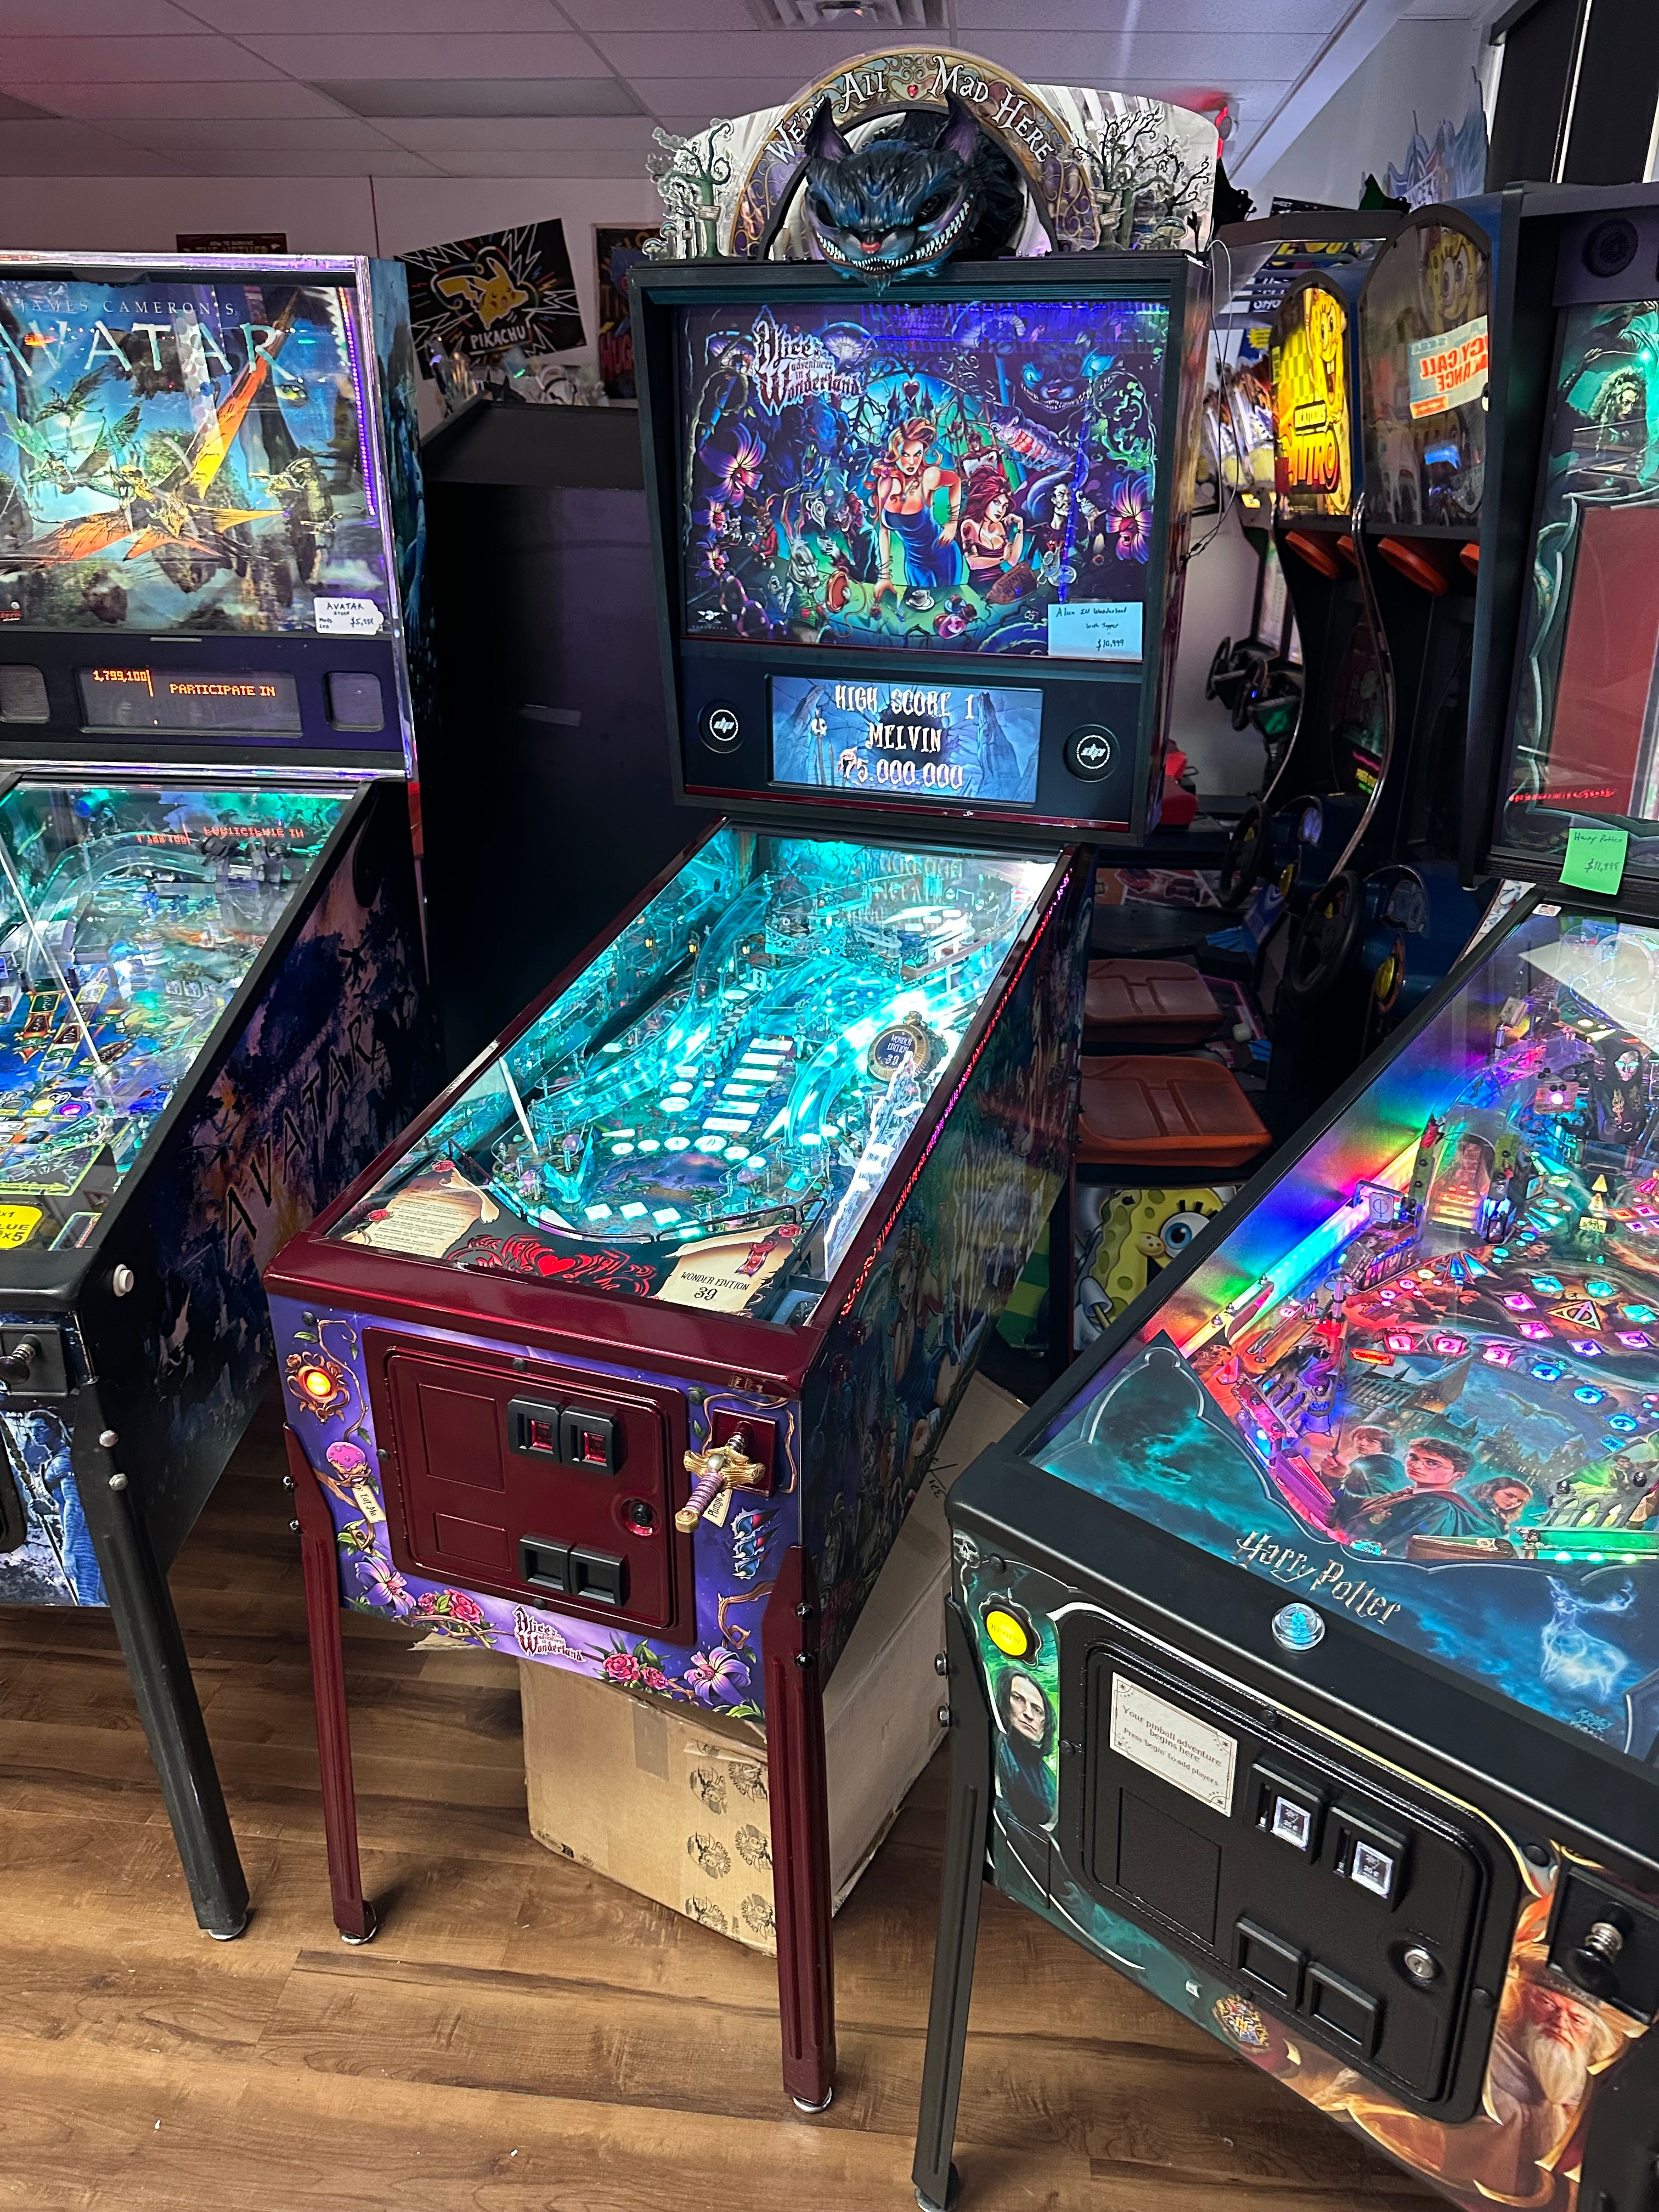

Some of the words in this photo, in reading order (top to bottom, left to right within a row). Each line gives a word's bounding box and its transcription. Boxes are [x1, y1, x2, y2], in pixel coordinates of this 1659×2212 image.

[21, 300, 88, 313] JAMES
[470, 327, 527, 349] PIKACHU
[326, 602, 365, 611] AVATAR
[93, 670, 148, 682] 1,799,100
[169, 683, 256, 696] PARTICIPATE
[259, 686, 276, 697] IN
[834, 685, 878, 713] HIGH
[890, 688, 952, 718] SCORE
[964, 693, 975, 720] 1
[865, 722, 943, 753] MELVIN
[680, 1272, 715, 1286] WONDER
[715, 1278, 751, 1291] EDITION
[693, 1286, 718, 1301] 39
[1230, 1531, 1317, 1583] Harry
[1310, 1559, 1401, 1625] Potter
[517, 1633, 583, 1661] Wonderland
[1122, 1705, 1144, 1722] Your
[1146, 1720, 1176, 1740] pinball
[1177, 1737, 1222, 1767] adventure
[1149, 1728, 1178, 1750] begins
[1179, 1744, 1200, 1763] here
[1124, 1728, 1143, 1743] Press
[1167, 1752, 1176, 1762] to
[1177, 1759, 1190, 1771] add
[1192, 1768, 1219, 1786] players
